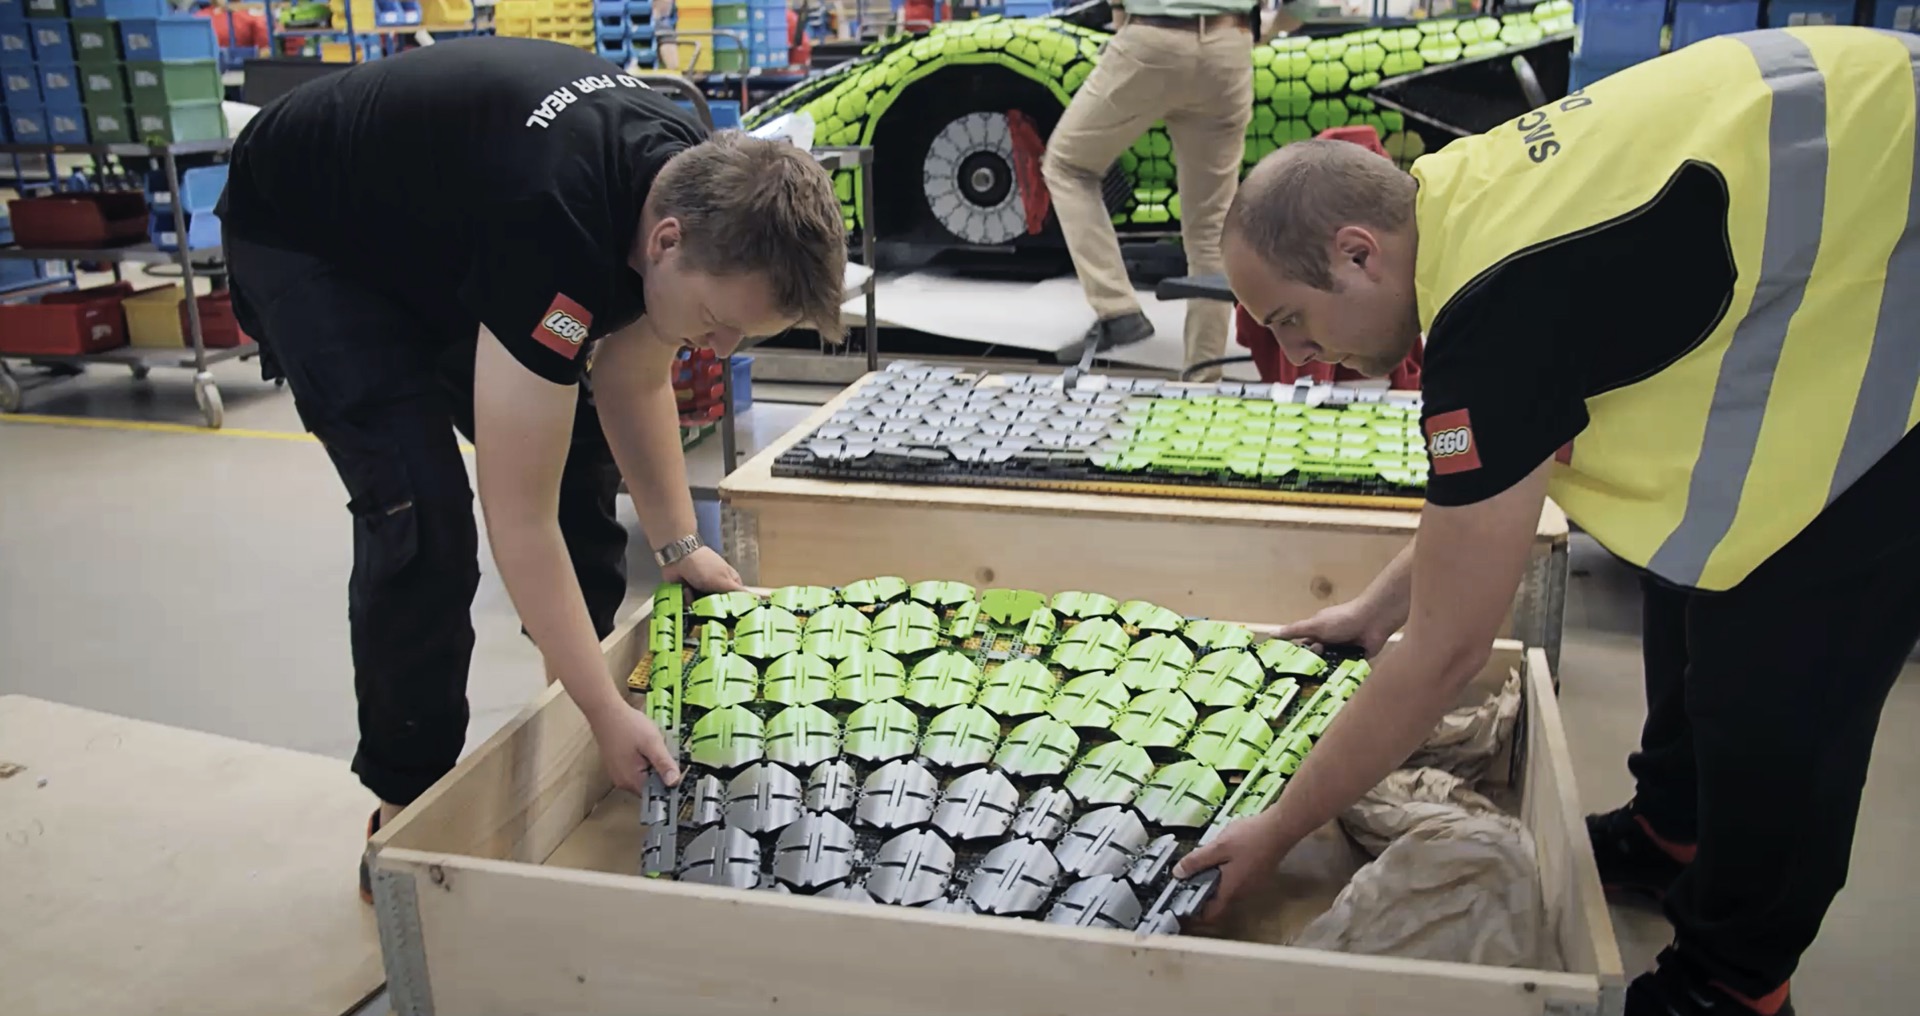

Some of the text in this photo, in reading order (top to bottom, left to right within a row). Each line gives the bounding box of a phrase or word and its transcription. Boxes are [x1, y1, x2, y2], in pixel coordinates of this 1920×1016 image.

[572, 74, 616, 94] FOR
[526, 86, 578, 129] REAL
[544, 311, 588, 343] LEGO
[1430, 428, 1470, 456] LEGO
